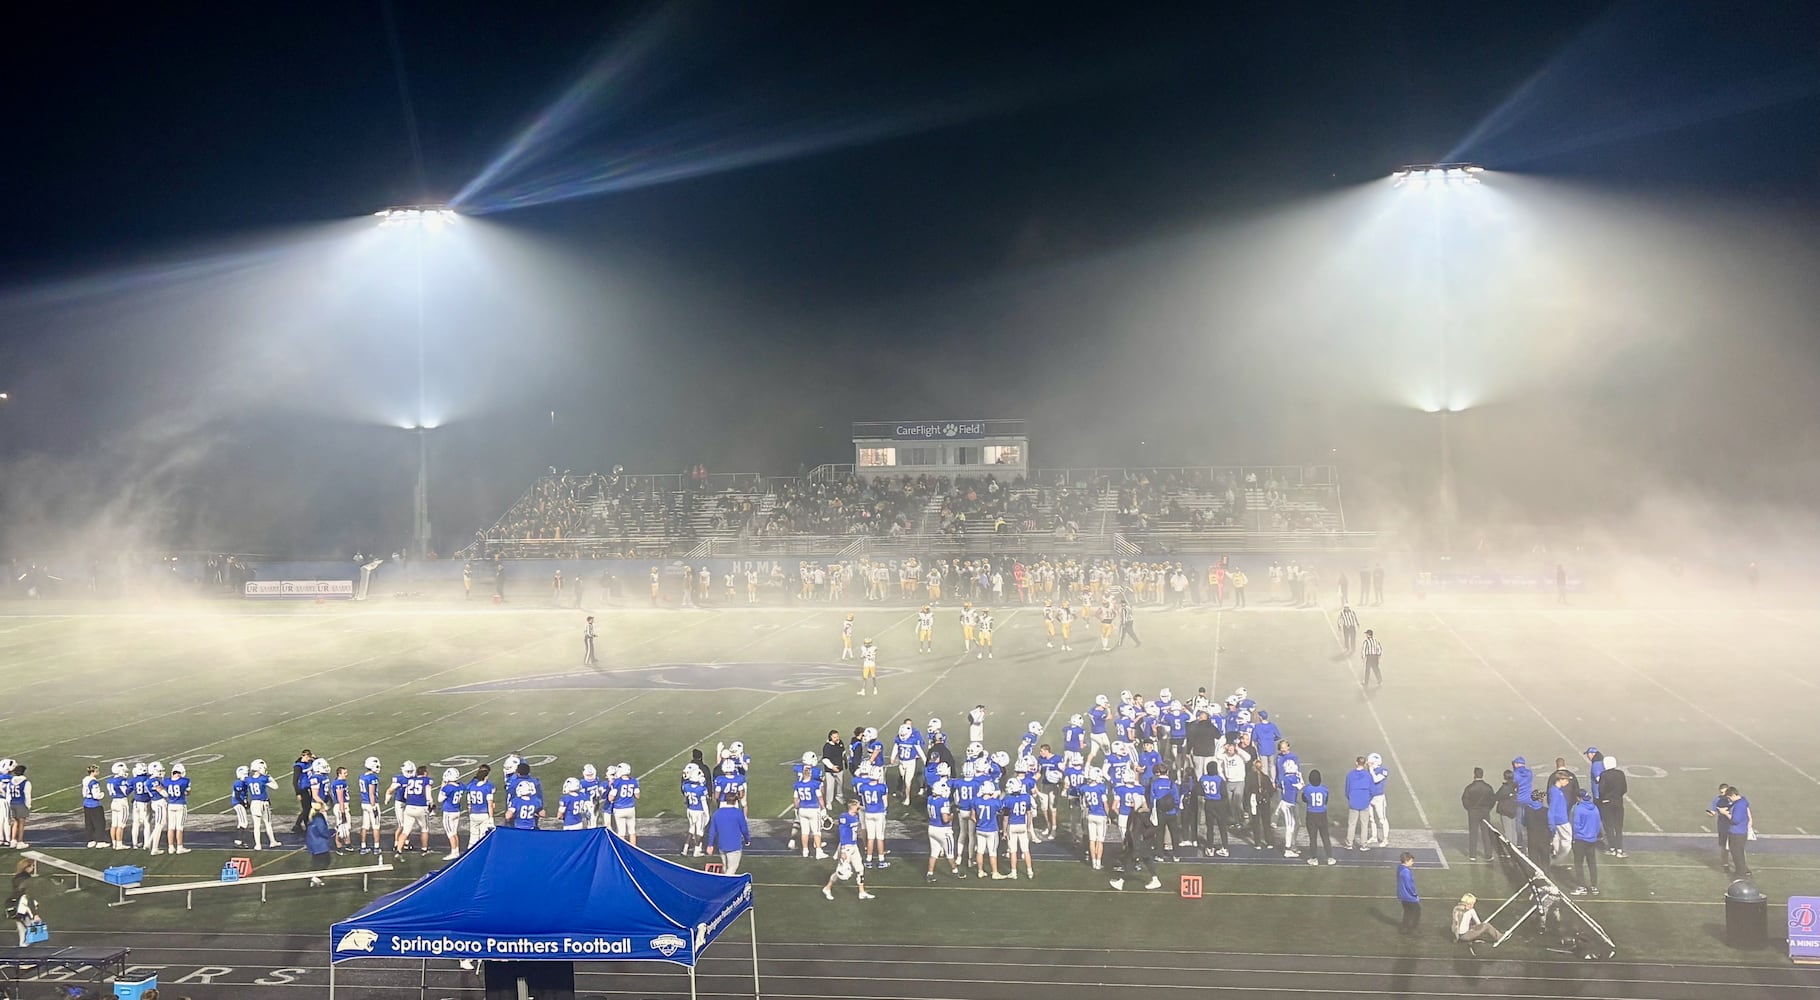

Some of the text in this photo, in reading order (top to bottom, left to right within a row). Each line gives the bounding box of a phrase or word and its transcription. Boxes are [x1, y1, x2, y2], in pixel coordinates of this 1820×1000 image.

[896, 425, 941, 437] CareFlight
[1174, 719, 1181, 730] 5
[429, 754, 559, 767] 50
[167, 784, 182, 797] 48
[249, 782, 261, 795] 18
[407, 779, 424, 796] 25
[620, 784, 635, 798] 65
[798, 787, 812, 801] 55
[961, 786, 973, 800] 81
[1203, 781, 1217, 794] 33
[470, 790, 484, 805] 59
[864, 790, 878, 804] 64
[1085, 791, 1098, 806] 28
[1311, 792, 1324, 807] 19
[520, 805, 534, 819] 62
[978, 805, 991, 819] 71
[1183, 878, 1201, 896] 30
[391, 935, 482, 955] Springboro
[487, 938, 559, 954] Panthers
[563, 938, 632, 953] Football
